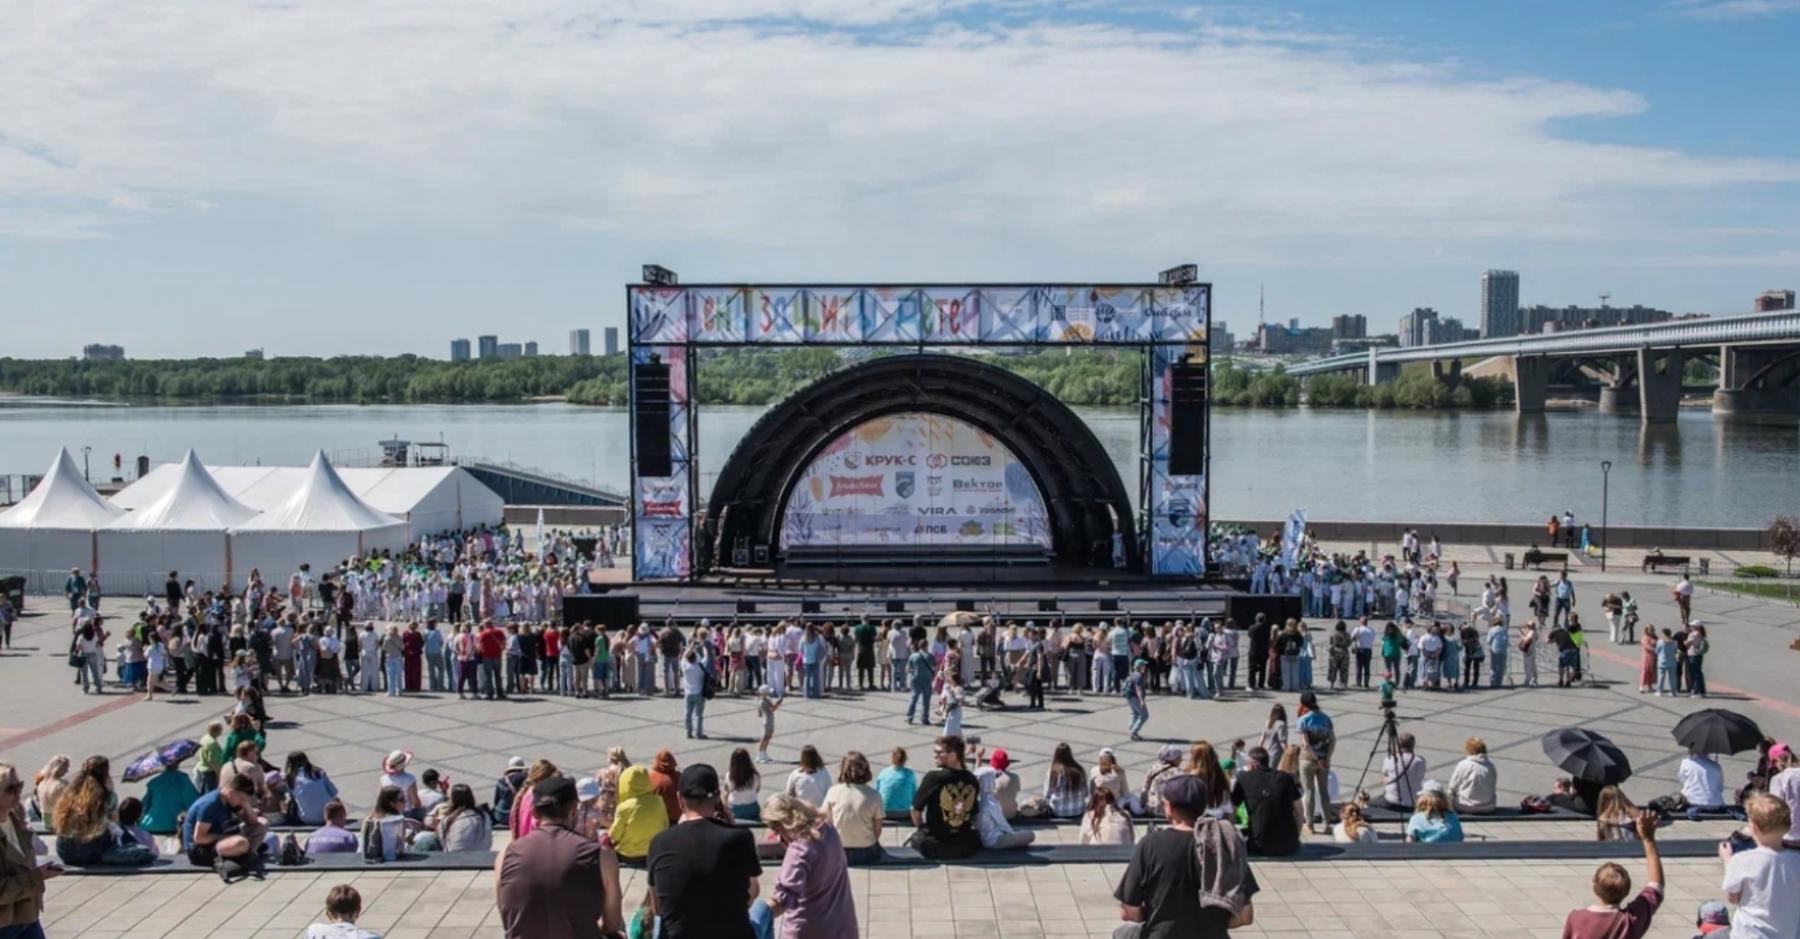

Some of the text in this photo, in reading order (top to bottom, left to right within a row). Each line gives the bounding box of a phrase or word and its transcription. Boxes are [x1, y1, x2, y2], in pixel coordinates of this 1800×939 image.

[865, 455, 917, 466] КРУК-С
[950, 455, 992, 466] СОЮЗ
[917, 506, 957, 515] VIRA
[926, 524, 947, 534] ПСБ
